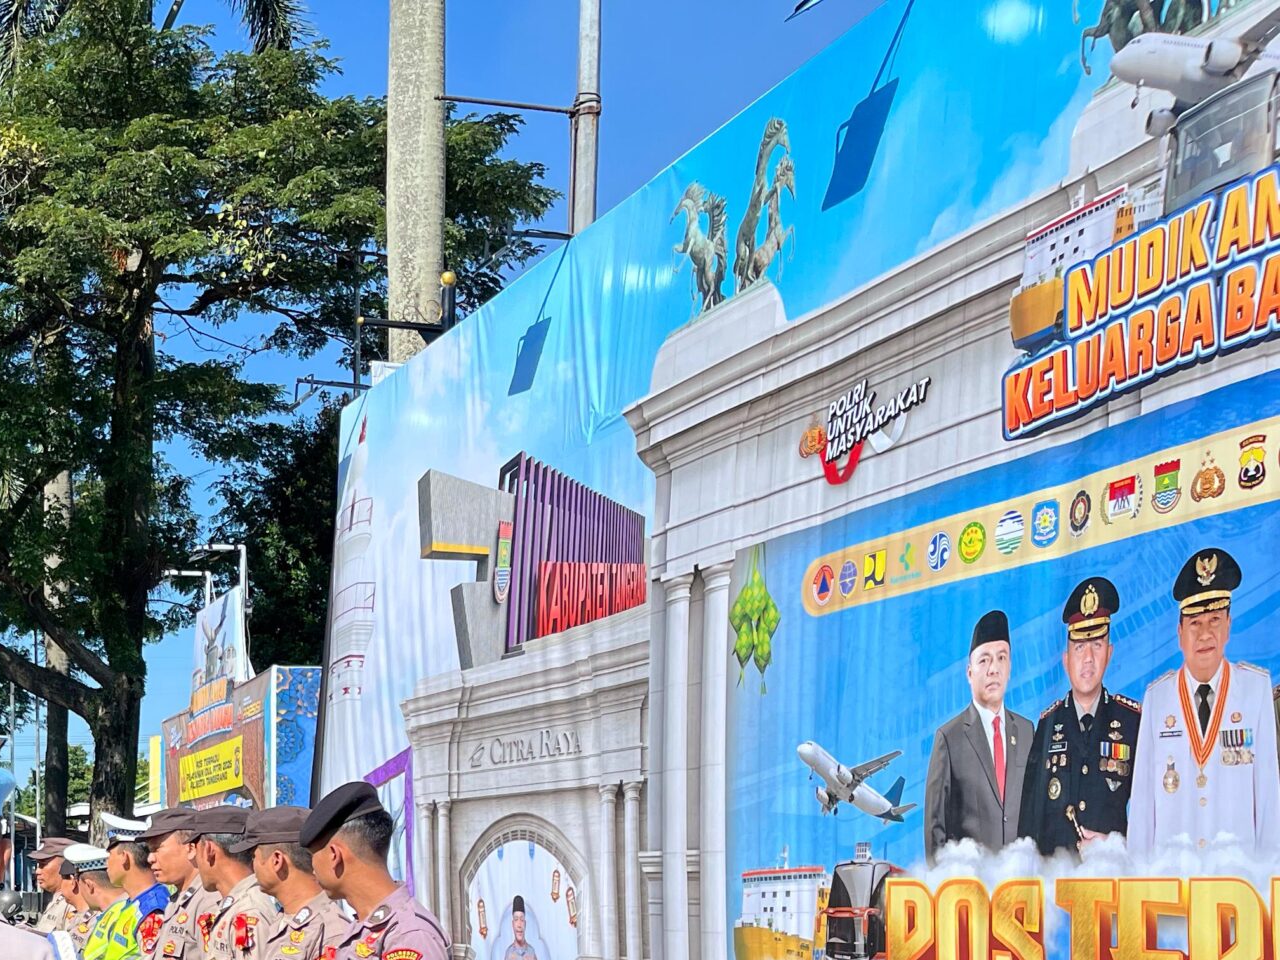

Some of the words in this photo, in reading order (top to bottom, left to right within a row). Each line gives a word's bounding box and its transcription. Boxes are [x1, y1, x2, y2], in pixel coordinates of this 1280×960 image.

[1068, 200, 1211, 332] MUDIK
[1005, 281, 1216, 432] KELUARGA
[824, 376, 932, 465] MASYARAKAT
[827, 378, 869, 421] POLRI
[827, 391, 877, 442] UNTUK
[536, 560, 610, 639] KABUPATEN
[170, 925, 184, 935] POLRI
